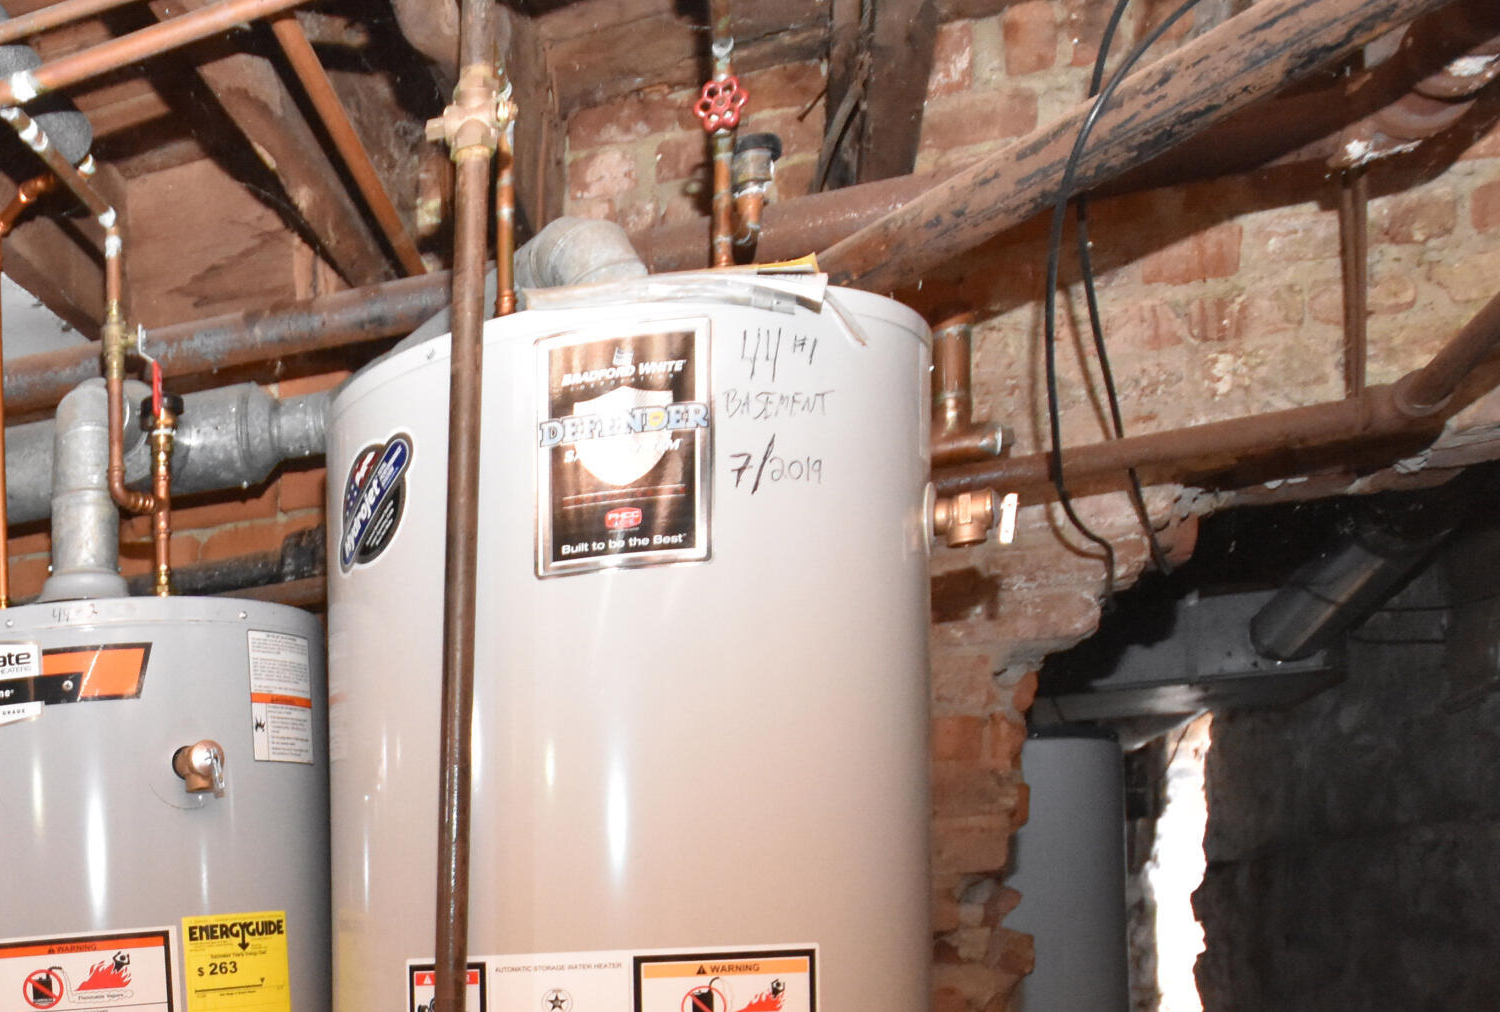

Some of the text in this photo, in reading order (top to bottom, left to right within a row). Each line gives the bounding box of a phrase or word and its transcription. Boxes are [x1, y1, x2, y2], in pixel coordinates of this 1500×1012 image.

[724, 389, 835, 420] BASEMENT
[540, 403, 709, 447] DEFENDER
[561, 542, 589, 555] Built
[592, 541, 605, 551] to
[609, 538, 624, 550] be
[628, 536, 649, 547] the
[188, 919, 284, 943] ENERGYGUIDE
[197, 961, 238, 977] $ 263
[710, 963, 761, 973] WARNING
